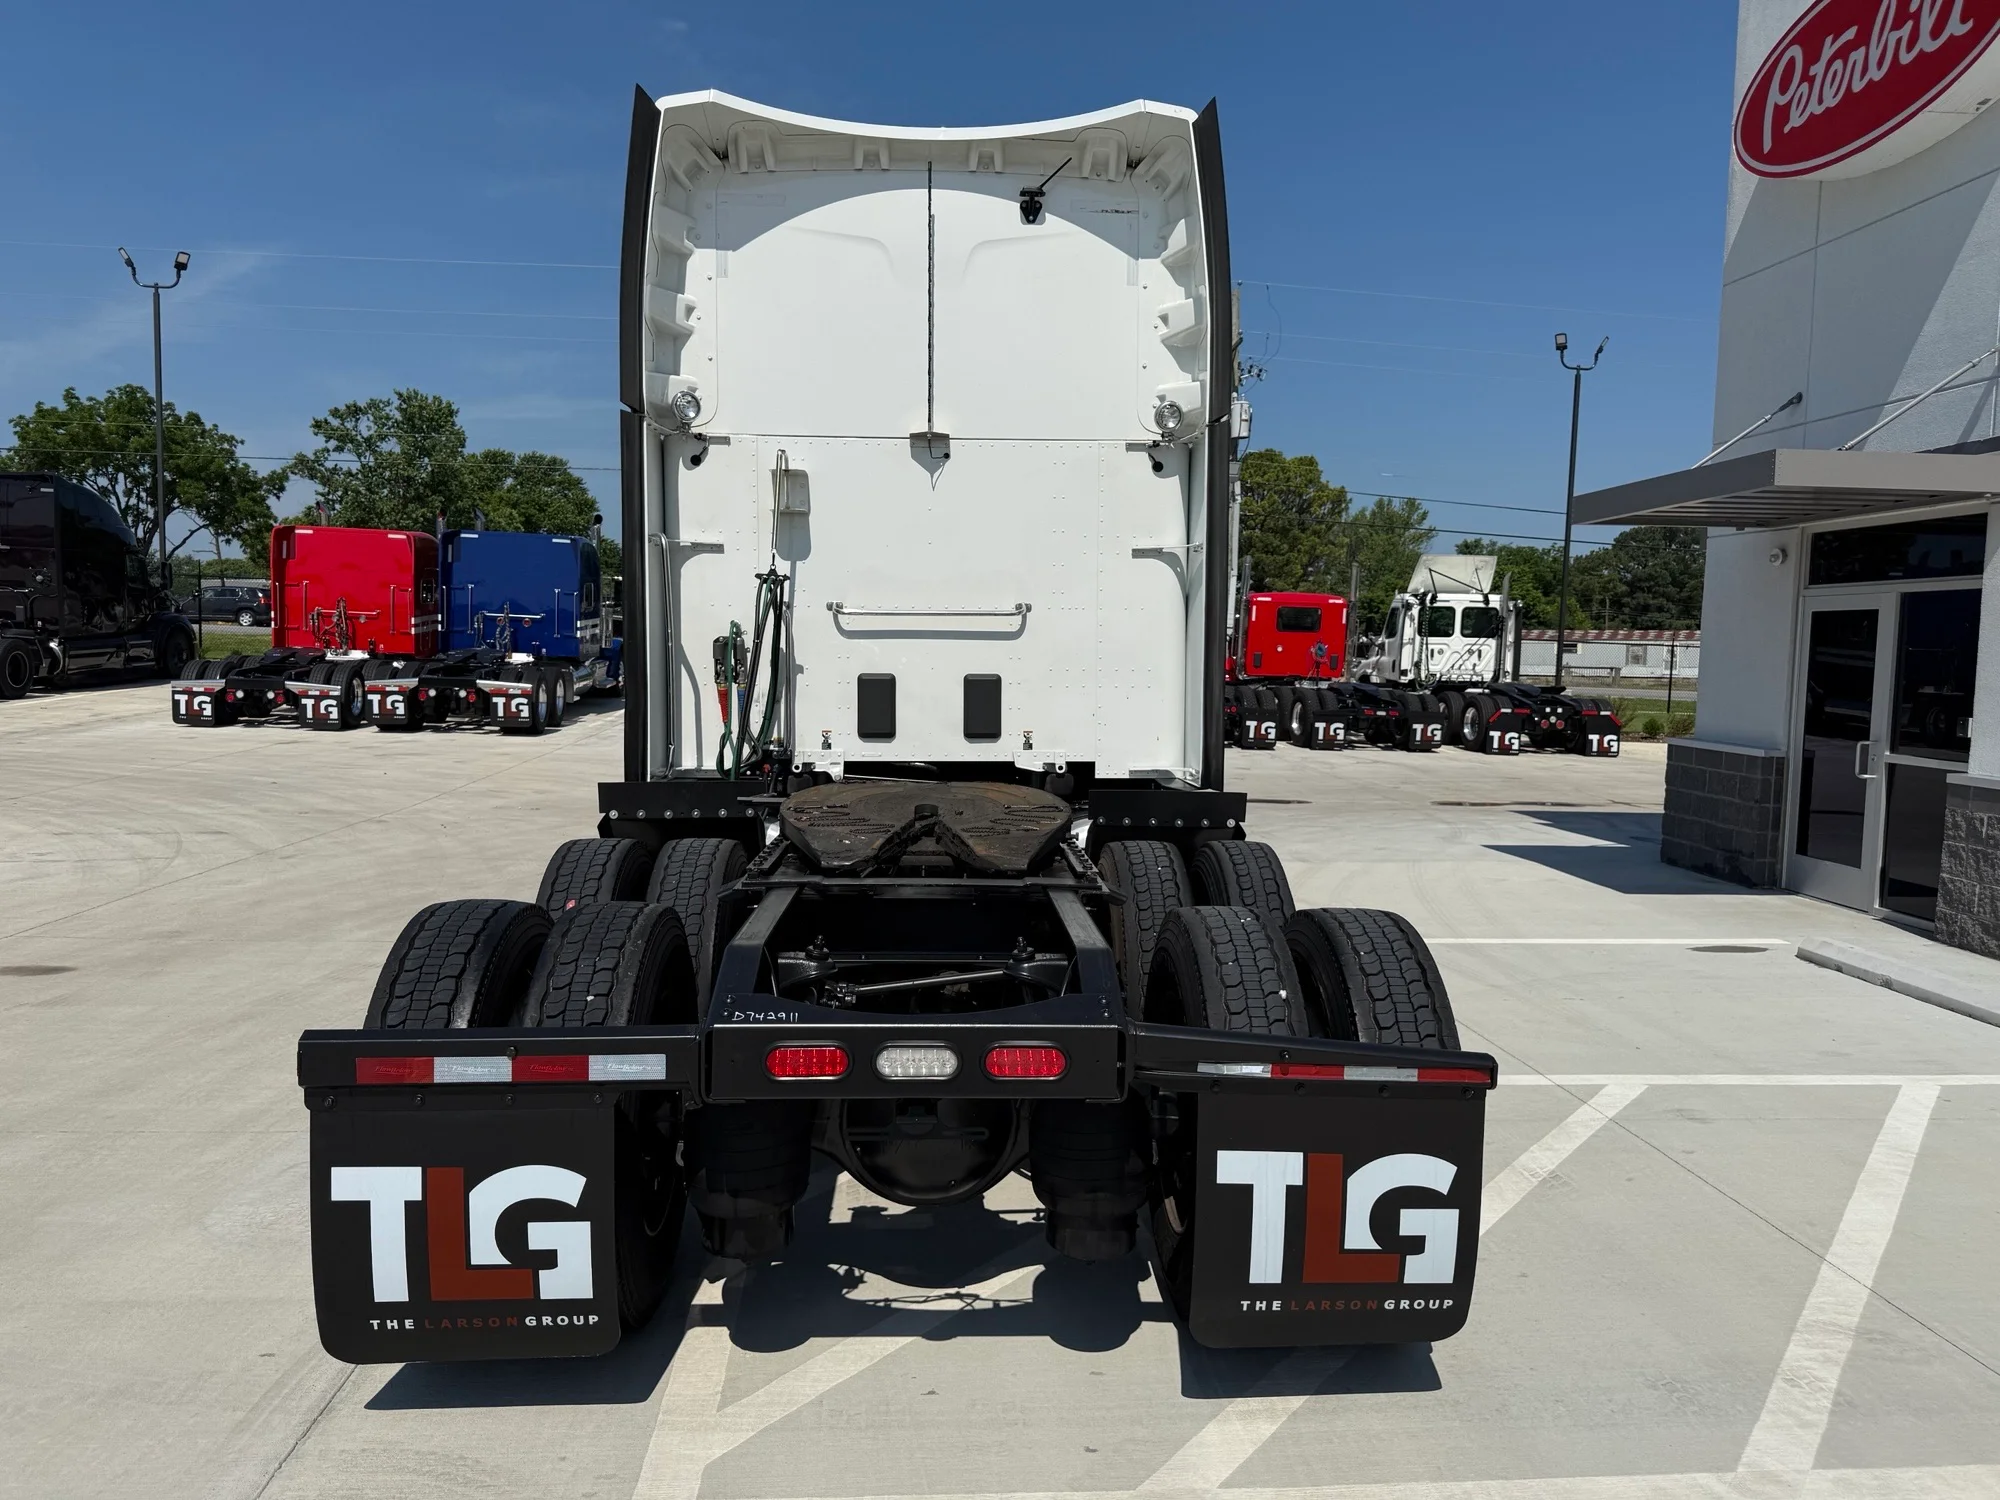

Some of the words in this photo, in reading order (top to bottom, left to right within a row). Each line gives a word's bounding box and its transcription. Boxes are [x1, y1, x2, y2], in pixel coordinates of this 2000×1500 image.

[174, 694, 211, 717] TLG
[302, 699, 338, 720] TLG
[368, 694, 404, 715] TLG
[493, 697, 529, 718] TLG
[1246, 721, 1276, 740] TLG
[1315, 722, 1345, 741] TLG
[1413, 724, 1442, 742] TLG
[1489, 730, 1519, 750] TLG
[1588, 735, 1618, 753] TLG
[731, 1011, 799, 1023] D742911
[1216, 1150, 1460, 1284] TLG
[331, 1164, 594, 1303] TLG
[1240, 1300, 1282, 1311] THE
[1290, 1300, 1377, 1311] LARSON
[1384, 1299, 1455, 1310] GROUP
[369, 1318, 415, 1330] THE
[424, 1316, 518, 1329] LARSON
[524, 1314, 600, 1326] GROUP
